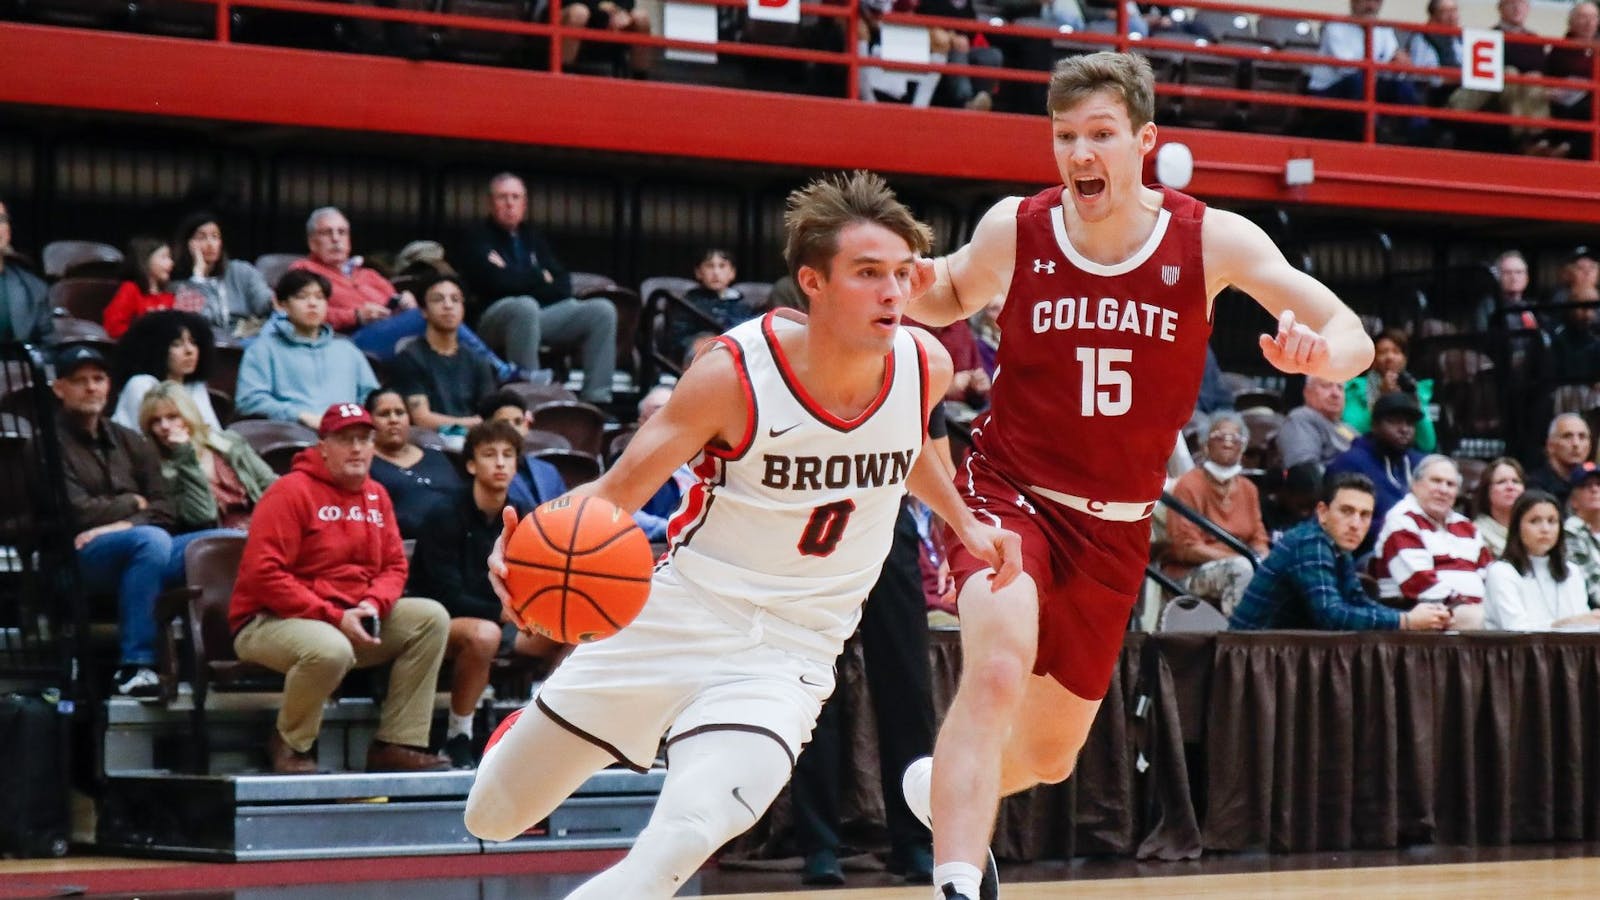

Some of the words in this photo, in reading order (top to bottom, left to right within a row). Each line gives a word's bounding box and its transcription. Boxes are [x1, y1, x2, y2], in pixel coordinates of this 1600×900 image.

[1472, 40, 1495, 79] E
[1032, 297, 1179, 342] COLGATE
[1076, 347, 1133, 417] 15
[761, 448, 914, 491] BROWN
[318, 505, 385, 528] COGTE
[797, 498, 857, 558] 0
